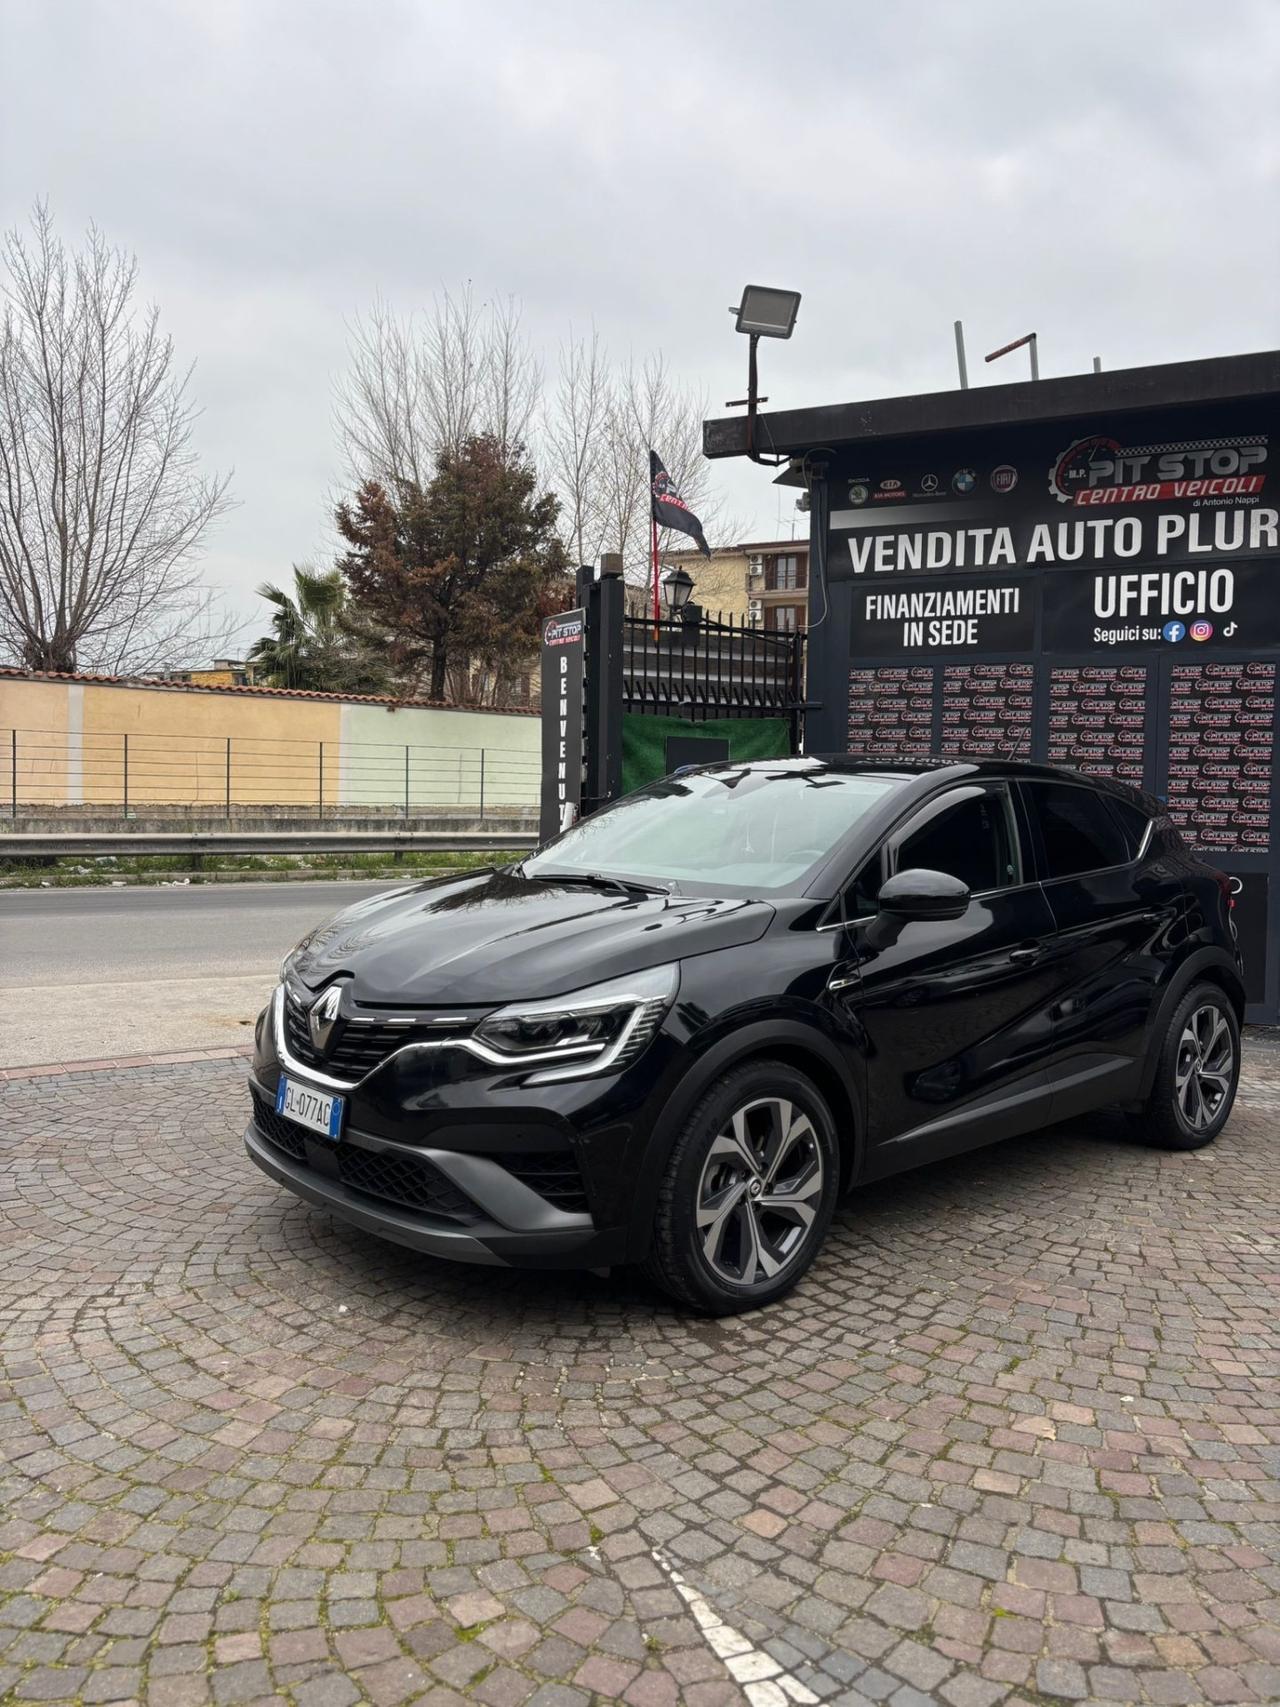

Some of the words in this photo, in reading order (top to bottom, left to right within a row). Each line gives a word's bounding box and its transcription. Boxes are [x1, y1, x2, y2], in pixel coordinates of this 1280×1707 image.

[1088, 457, 1151, 487] PIT
[1157, 446, 1268, 480] STOP
[1193, 499, 1201, 507] di
[1202, 497, 1233, 506] Antonio
[1235, 496, 1259, 506] Nappi
[848, 527, 1016, 573] VENDITA
[1027, 517, 1142, 562] AUTO
[1157, 508, 1279, 555] PLUR
[865, 587, 1020, 620] FINANZIAMENTI
[1094, 568, 1234, 618] UFFICIO
[903, 621, 923, 647] IN
[928, 619, 978, 646] SEDE
[1093, 626, 1140, 645] Seguici
[1142, 628, 1161, 641] su:
